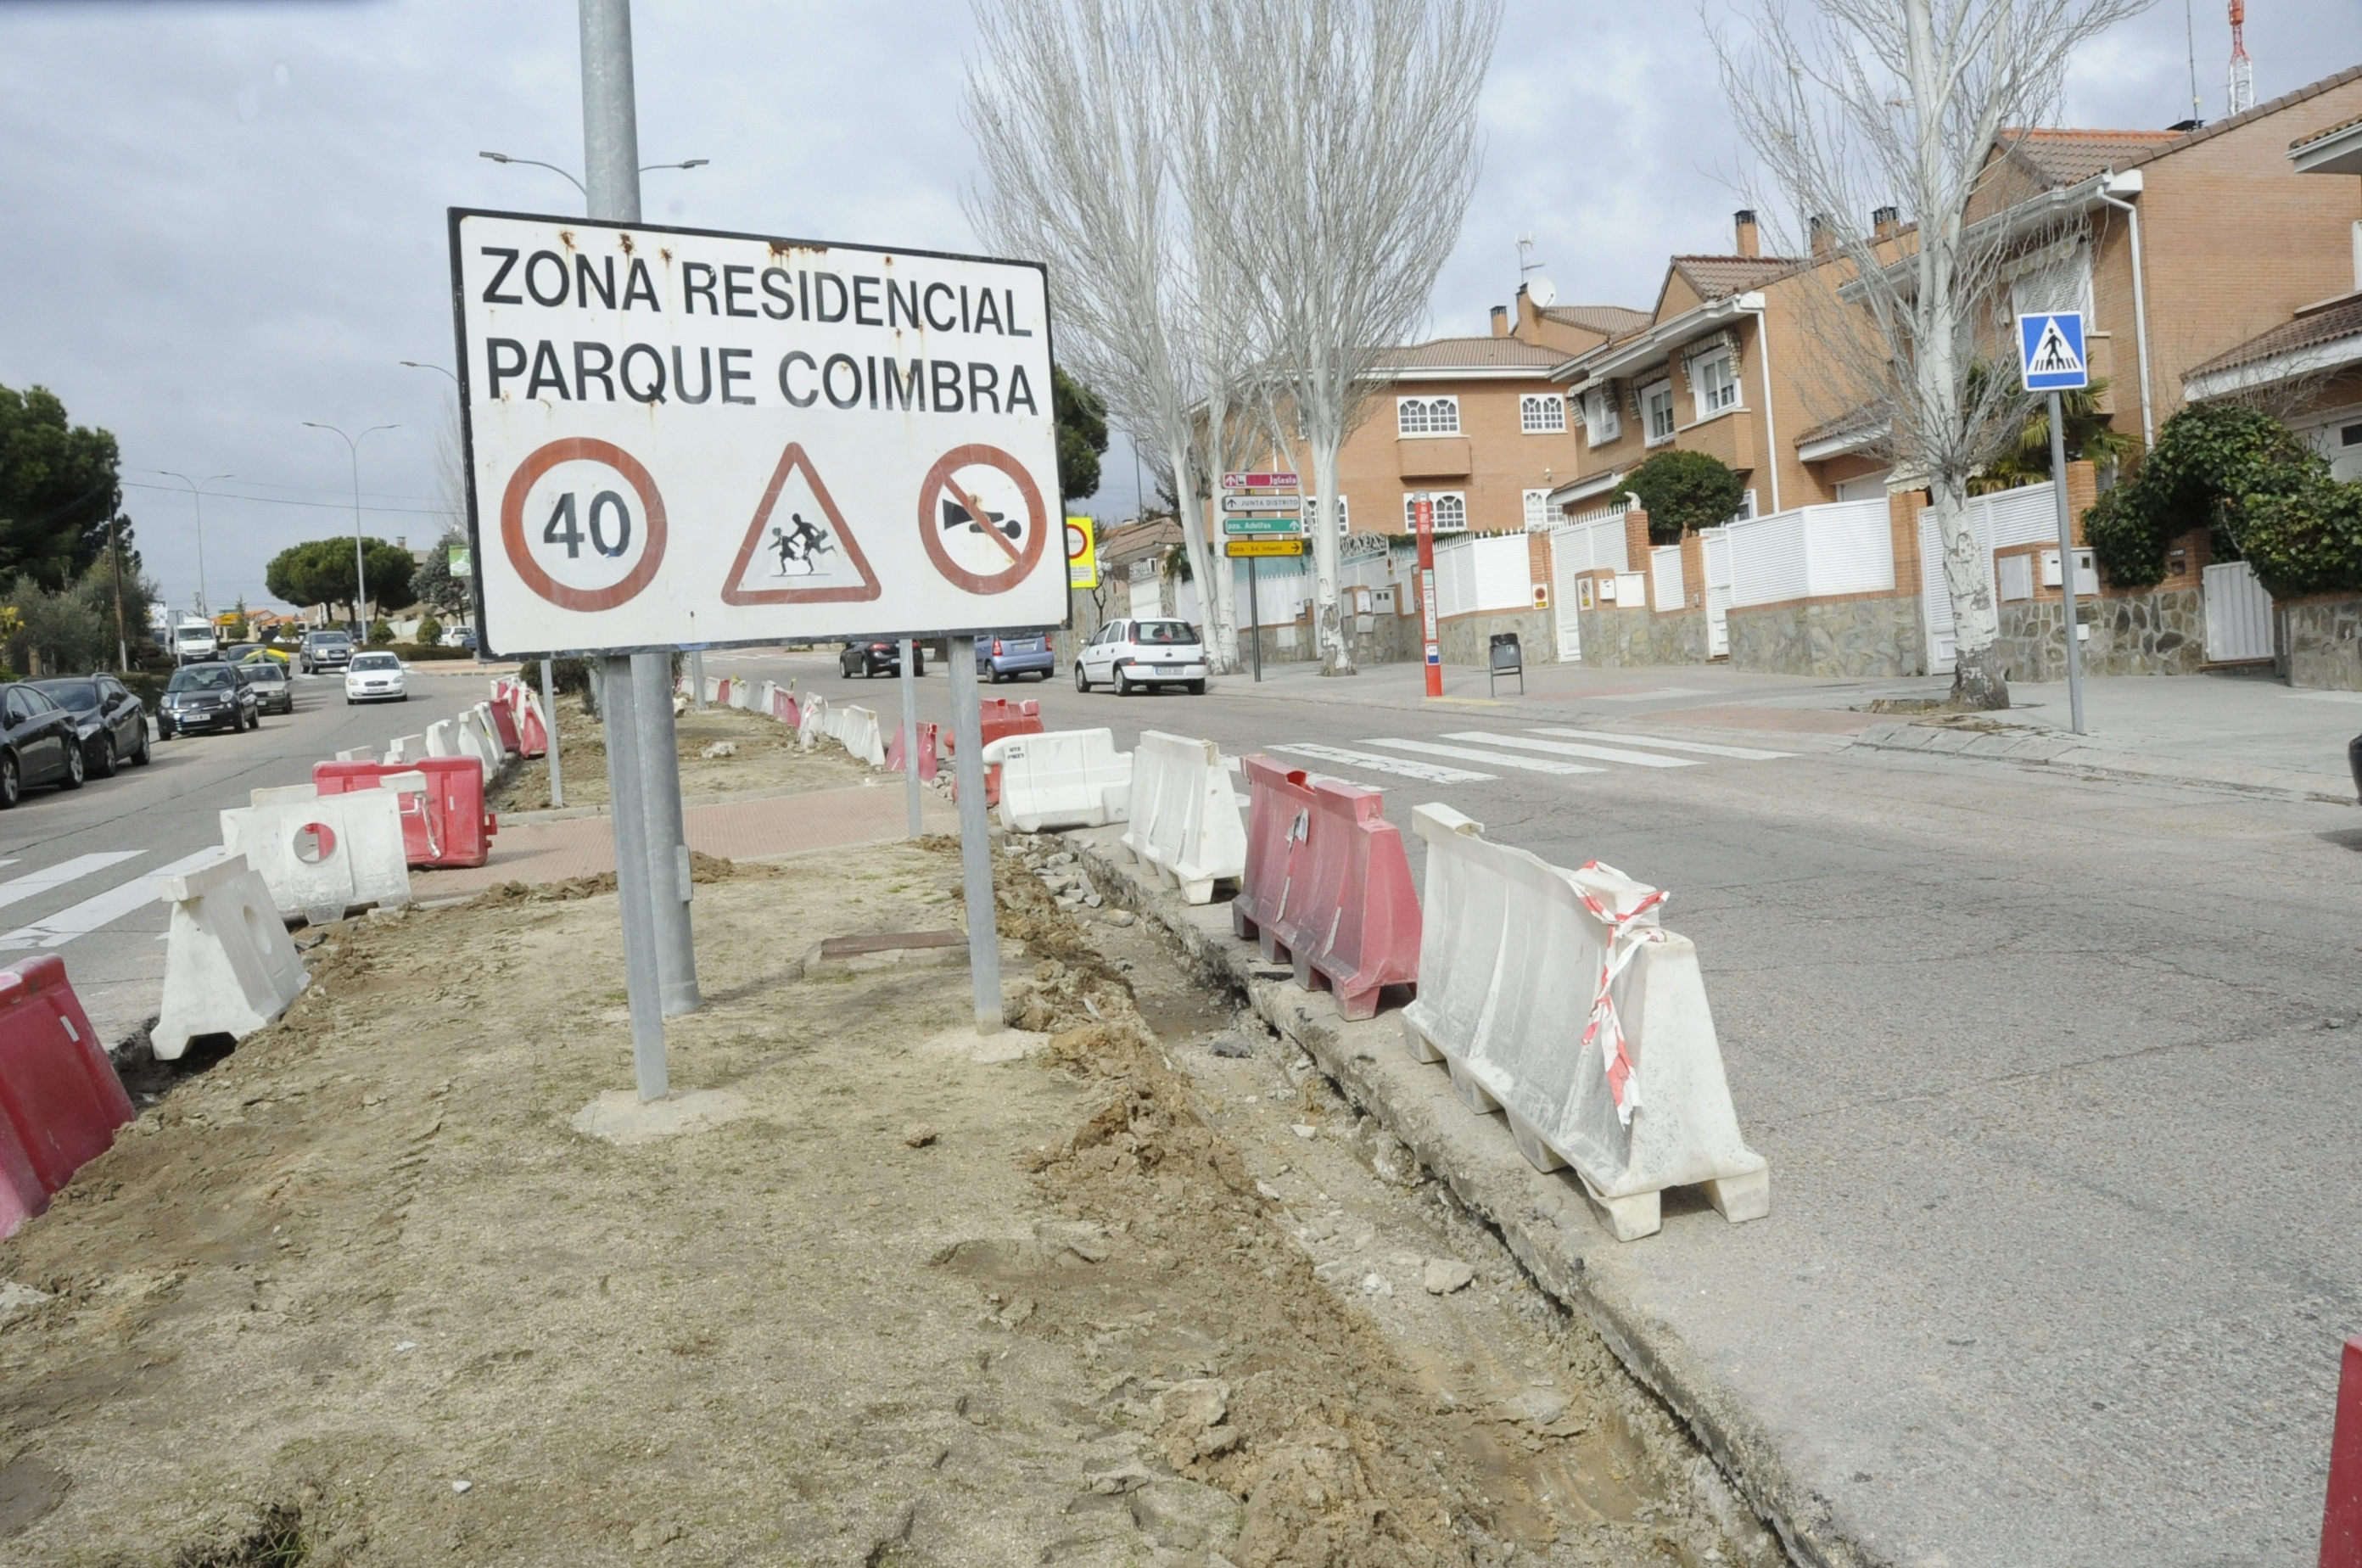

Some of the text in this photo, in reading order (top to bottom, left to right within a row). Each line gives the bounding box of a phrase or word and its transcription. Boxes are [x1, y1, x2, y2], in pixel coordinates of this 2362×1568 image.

[481, 246, 1033, 337] ZONA RESIDENCIAL
[486, 337, 1039, 416] PARQUE COIMBRA
[1269, 474, 1296, 485] Iglesia
[543, 490, 631, 559] 40
